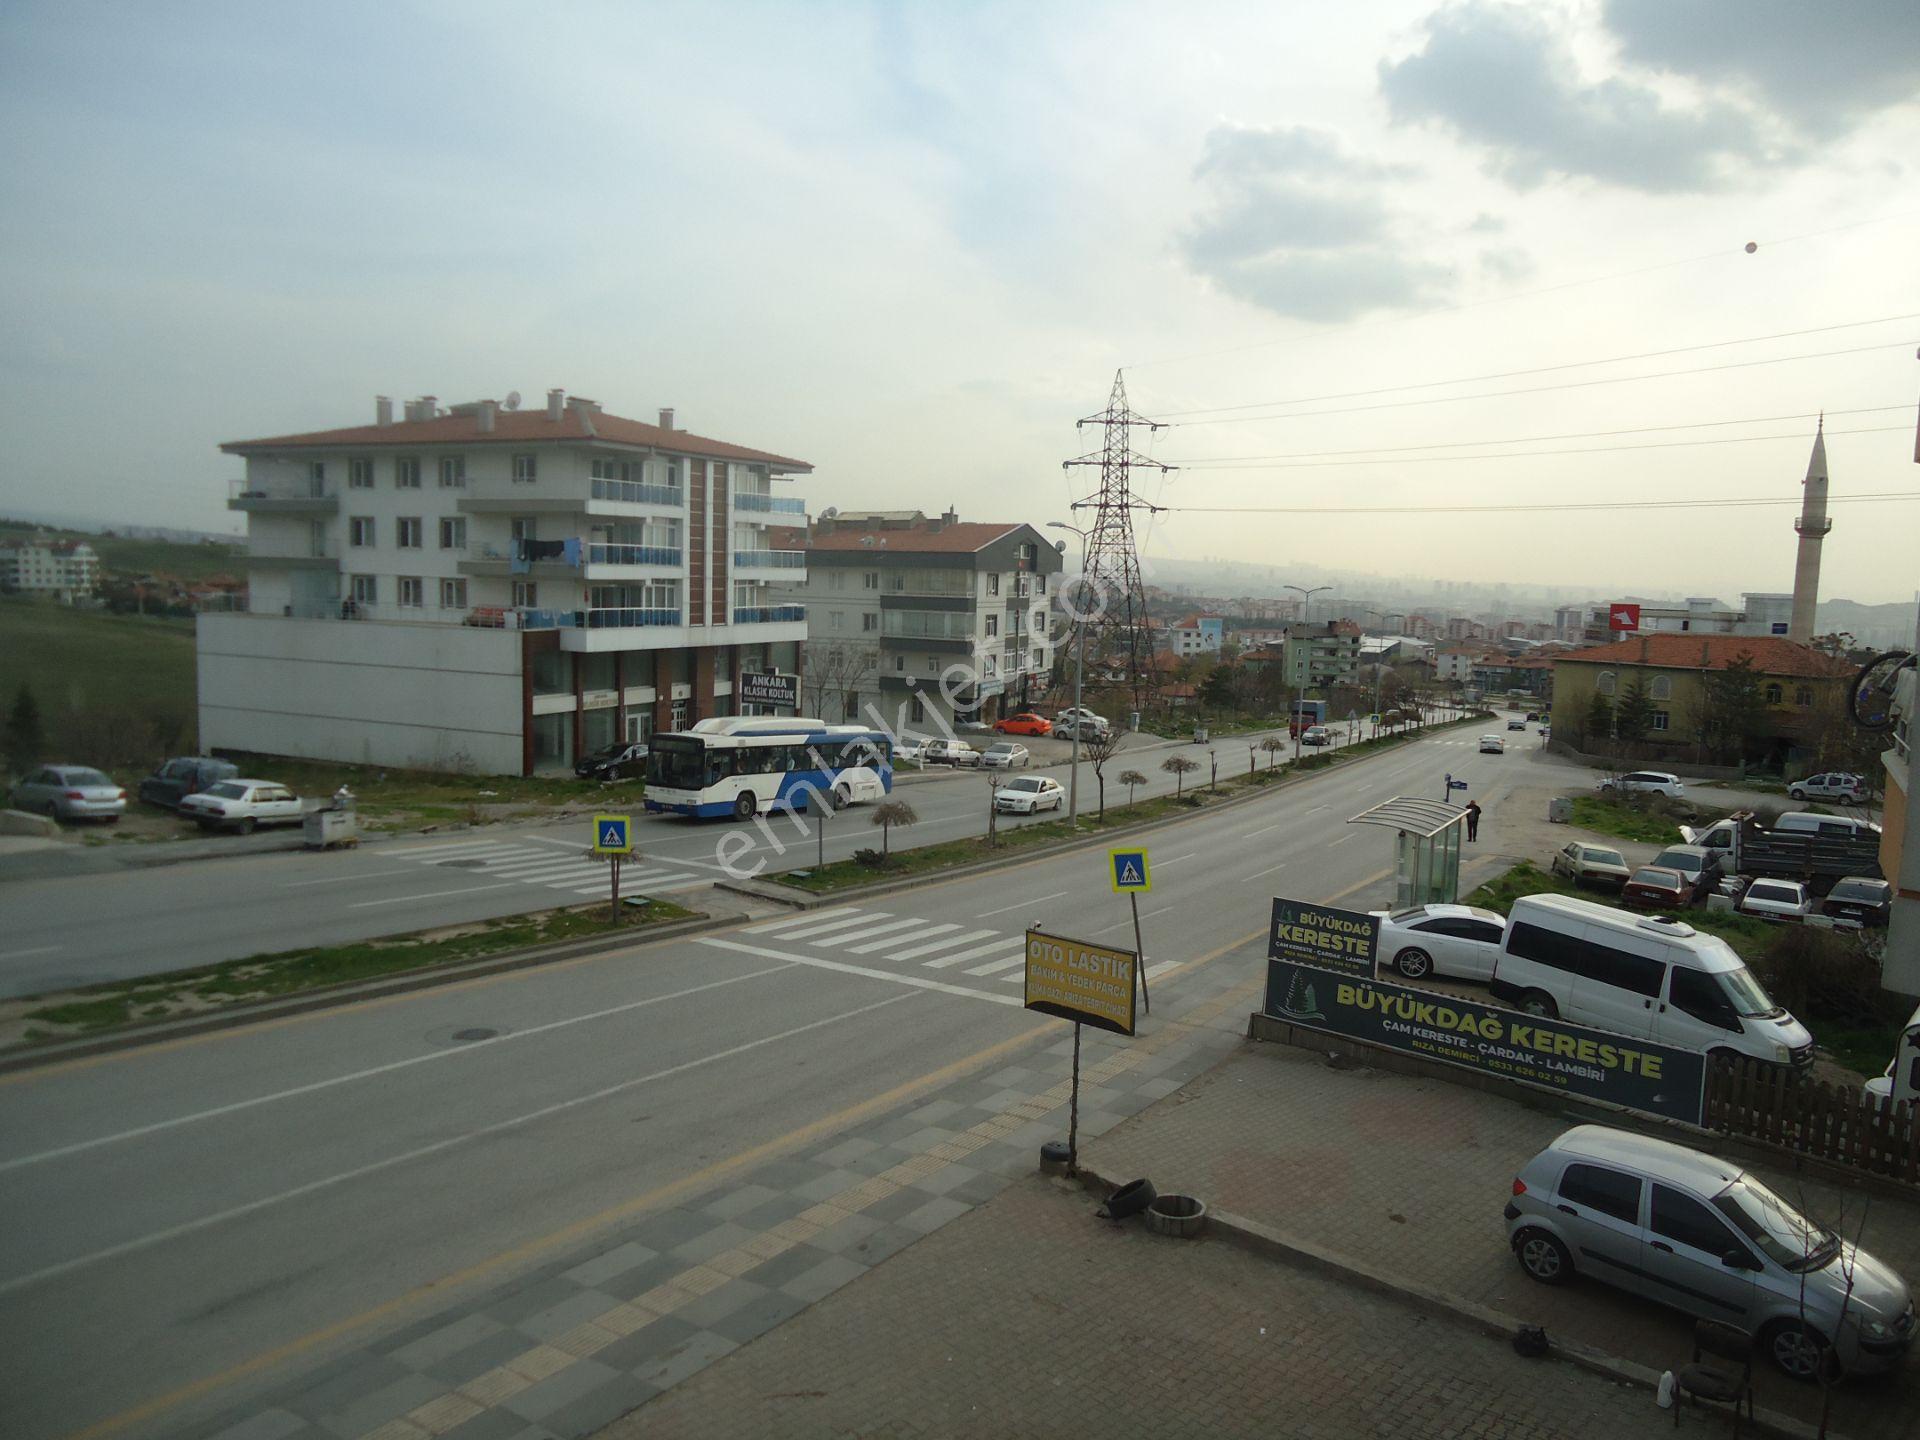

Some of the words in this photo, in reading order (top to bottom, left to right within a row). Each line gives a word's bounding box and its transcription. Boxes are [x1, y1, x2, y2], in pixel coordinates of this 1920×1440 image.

[752, 675, 787, 688] ANKARA
[769, 688, 794, 700] KOLTUK
[1277, 923, 1370, 957] KERESTE
[1300, 912, 1372, 936] BÜYÜKDAĞ
[1030, 940, 1064, 964] OTO
[1068, 949, 1130, 981] LASTİK
[1336, 983, 1503, 1040] BÜYÜKDAĞ
[1510, 1024, 1663, 1080] KERESTE
[1383, 1020, 1411, 1035] ÇAM
[1412, 1026, 1468, 1049] KERESTE
[1478, 1043, 1535, 1066] ÇARDAK
[1546, 1058, 1605, 1082] LAMBİRİ
[1412, 1040, 1436, 1052] RIZA
[1488, 1060, 1513, 1072] 0533
[1537, 1069, 1551, 1081] 02
